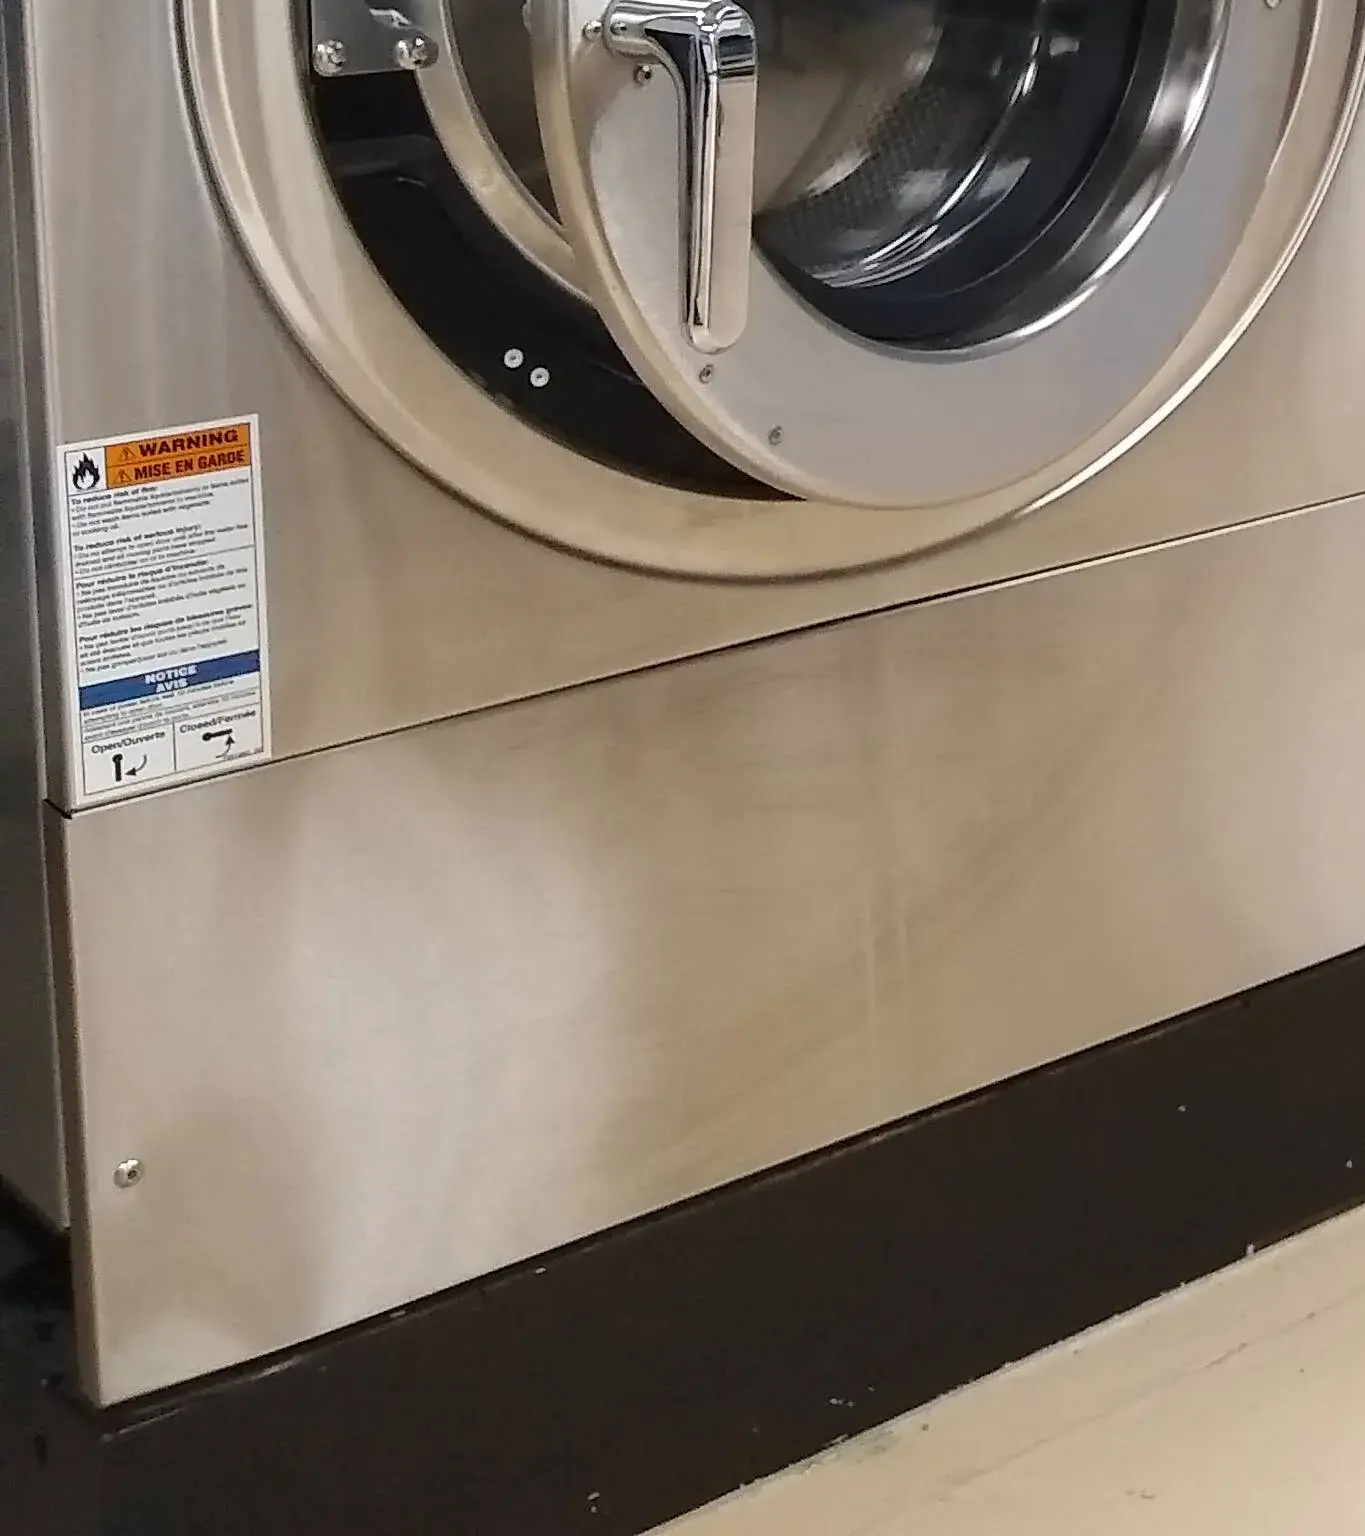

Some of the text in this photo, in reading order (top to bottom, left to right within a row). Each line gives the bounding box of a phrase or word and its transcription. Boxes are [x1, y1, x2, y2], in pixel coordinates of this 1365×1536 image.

[139, 429, 237, 456] WARNING
[134, 449, 244, 480] MISE EN GARDE
[144, 665, 197, 684] NOTICE
[155, 677, 188, 693] AVIS
